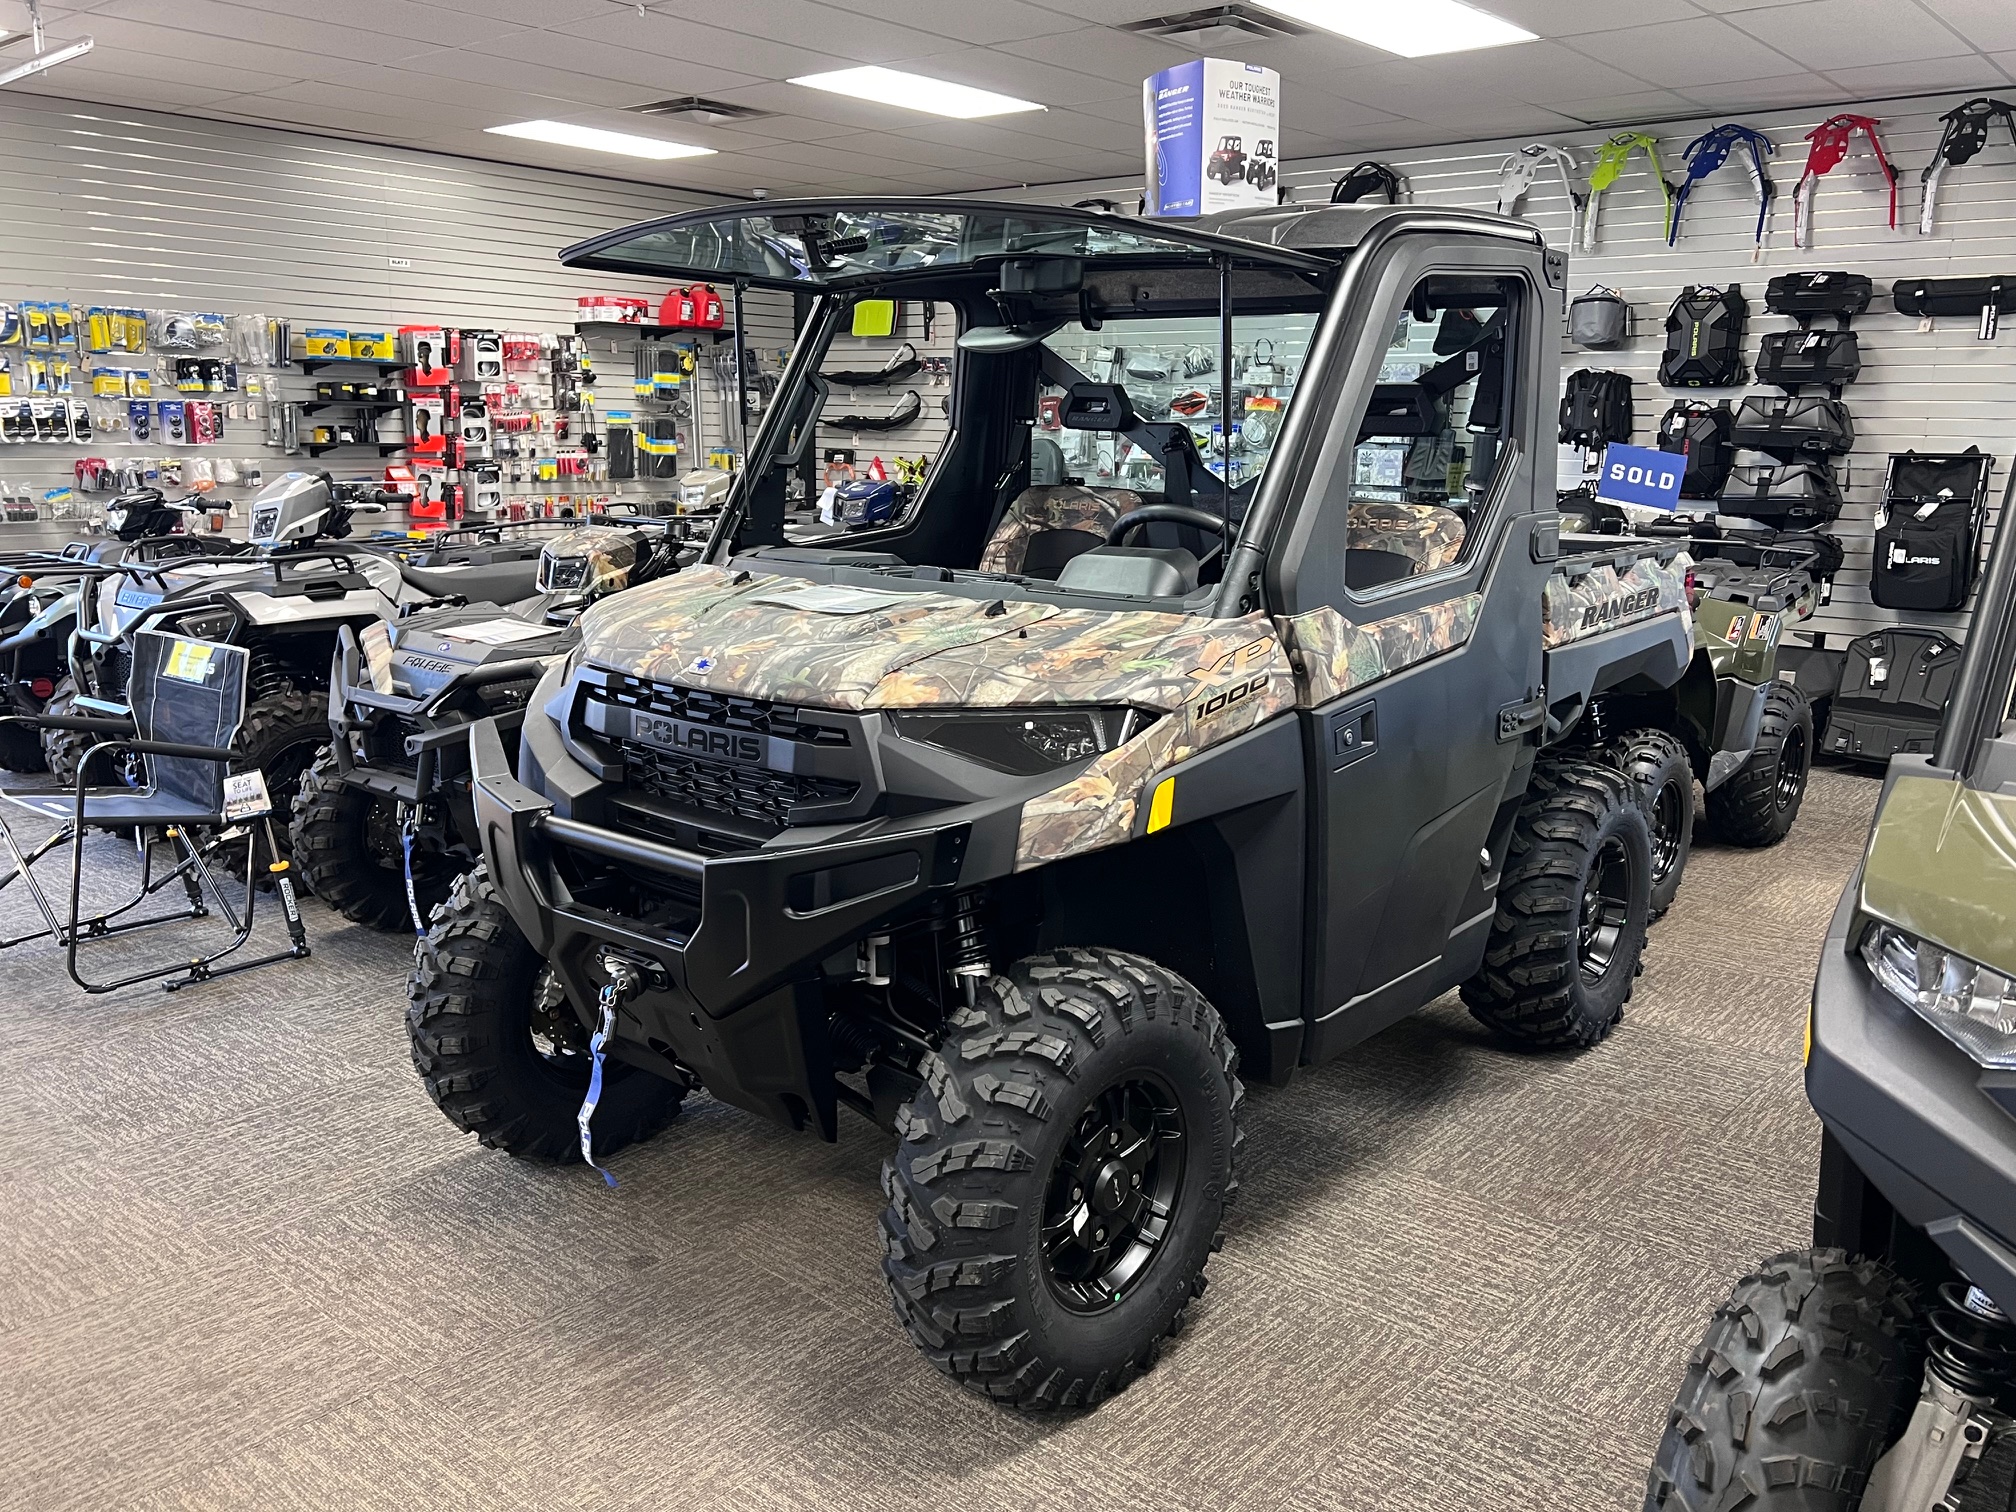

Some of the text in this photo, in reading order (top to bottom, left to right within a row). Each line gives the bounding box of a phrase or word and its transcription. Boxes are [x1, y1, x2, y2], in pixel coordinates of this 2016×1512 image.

[1219, 89, 1275, 108] WEATHER WARRIORS
[1229, 80, 1271, 96] OUR TOUGHEST
[1985, 305, 1996, 340] POLARIS
[1691, 321, 1700, 357] POLARIS
[1610, 463, 1675, 490] SOLD
[1050, 499, 1101, 511] OLARIS
[1346, 518, 1409, 530] OLARIS
[1905, 556, 1940, 565] LARIS
[1580, 587, 1660, 630] RANGER
[402, 656, 455, 673] POLARIS
[1176, 635, 1276, 709] XP
[1196, 674, 1270, 721] 1000
[635, 715, 762, 763] POLARIS
[233, 779, 252, 790] SEAT
[283, 883, 296, 916] ROCKER
[406, 879, 423, 929] POLARIS
